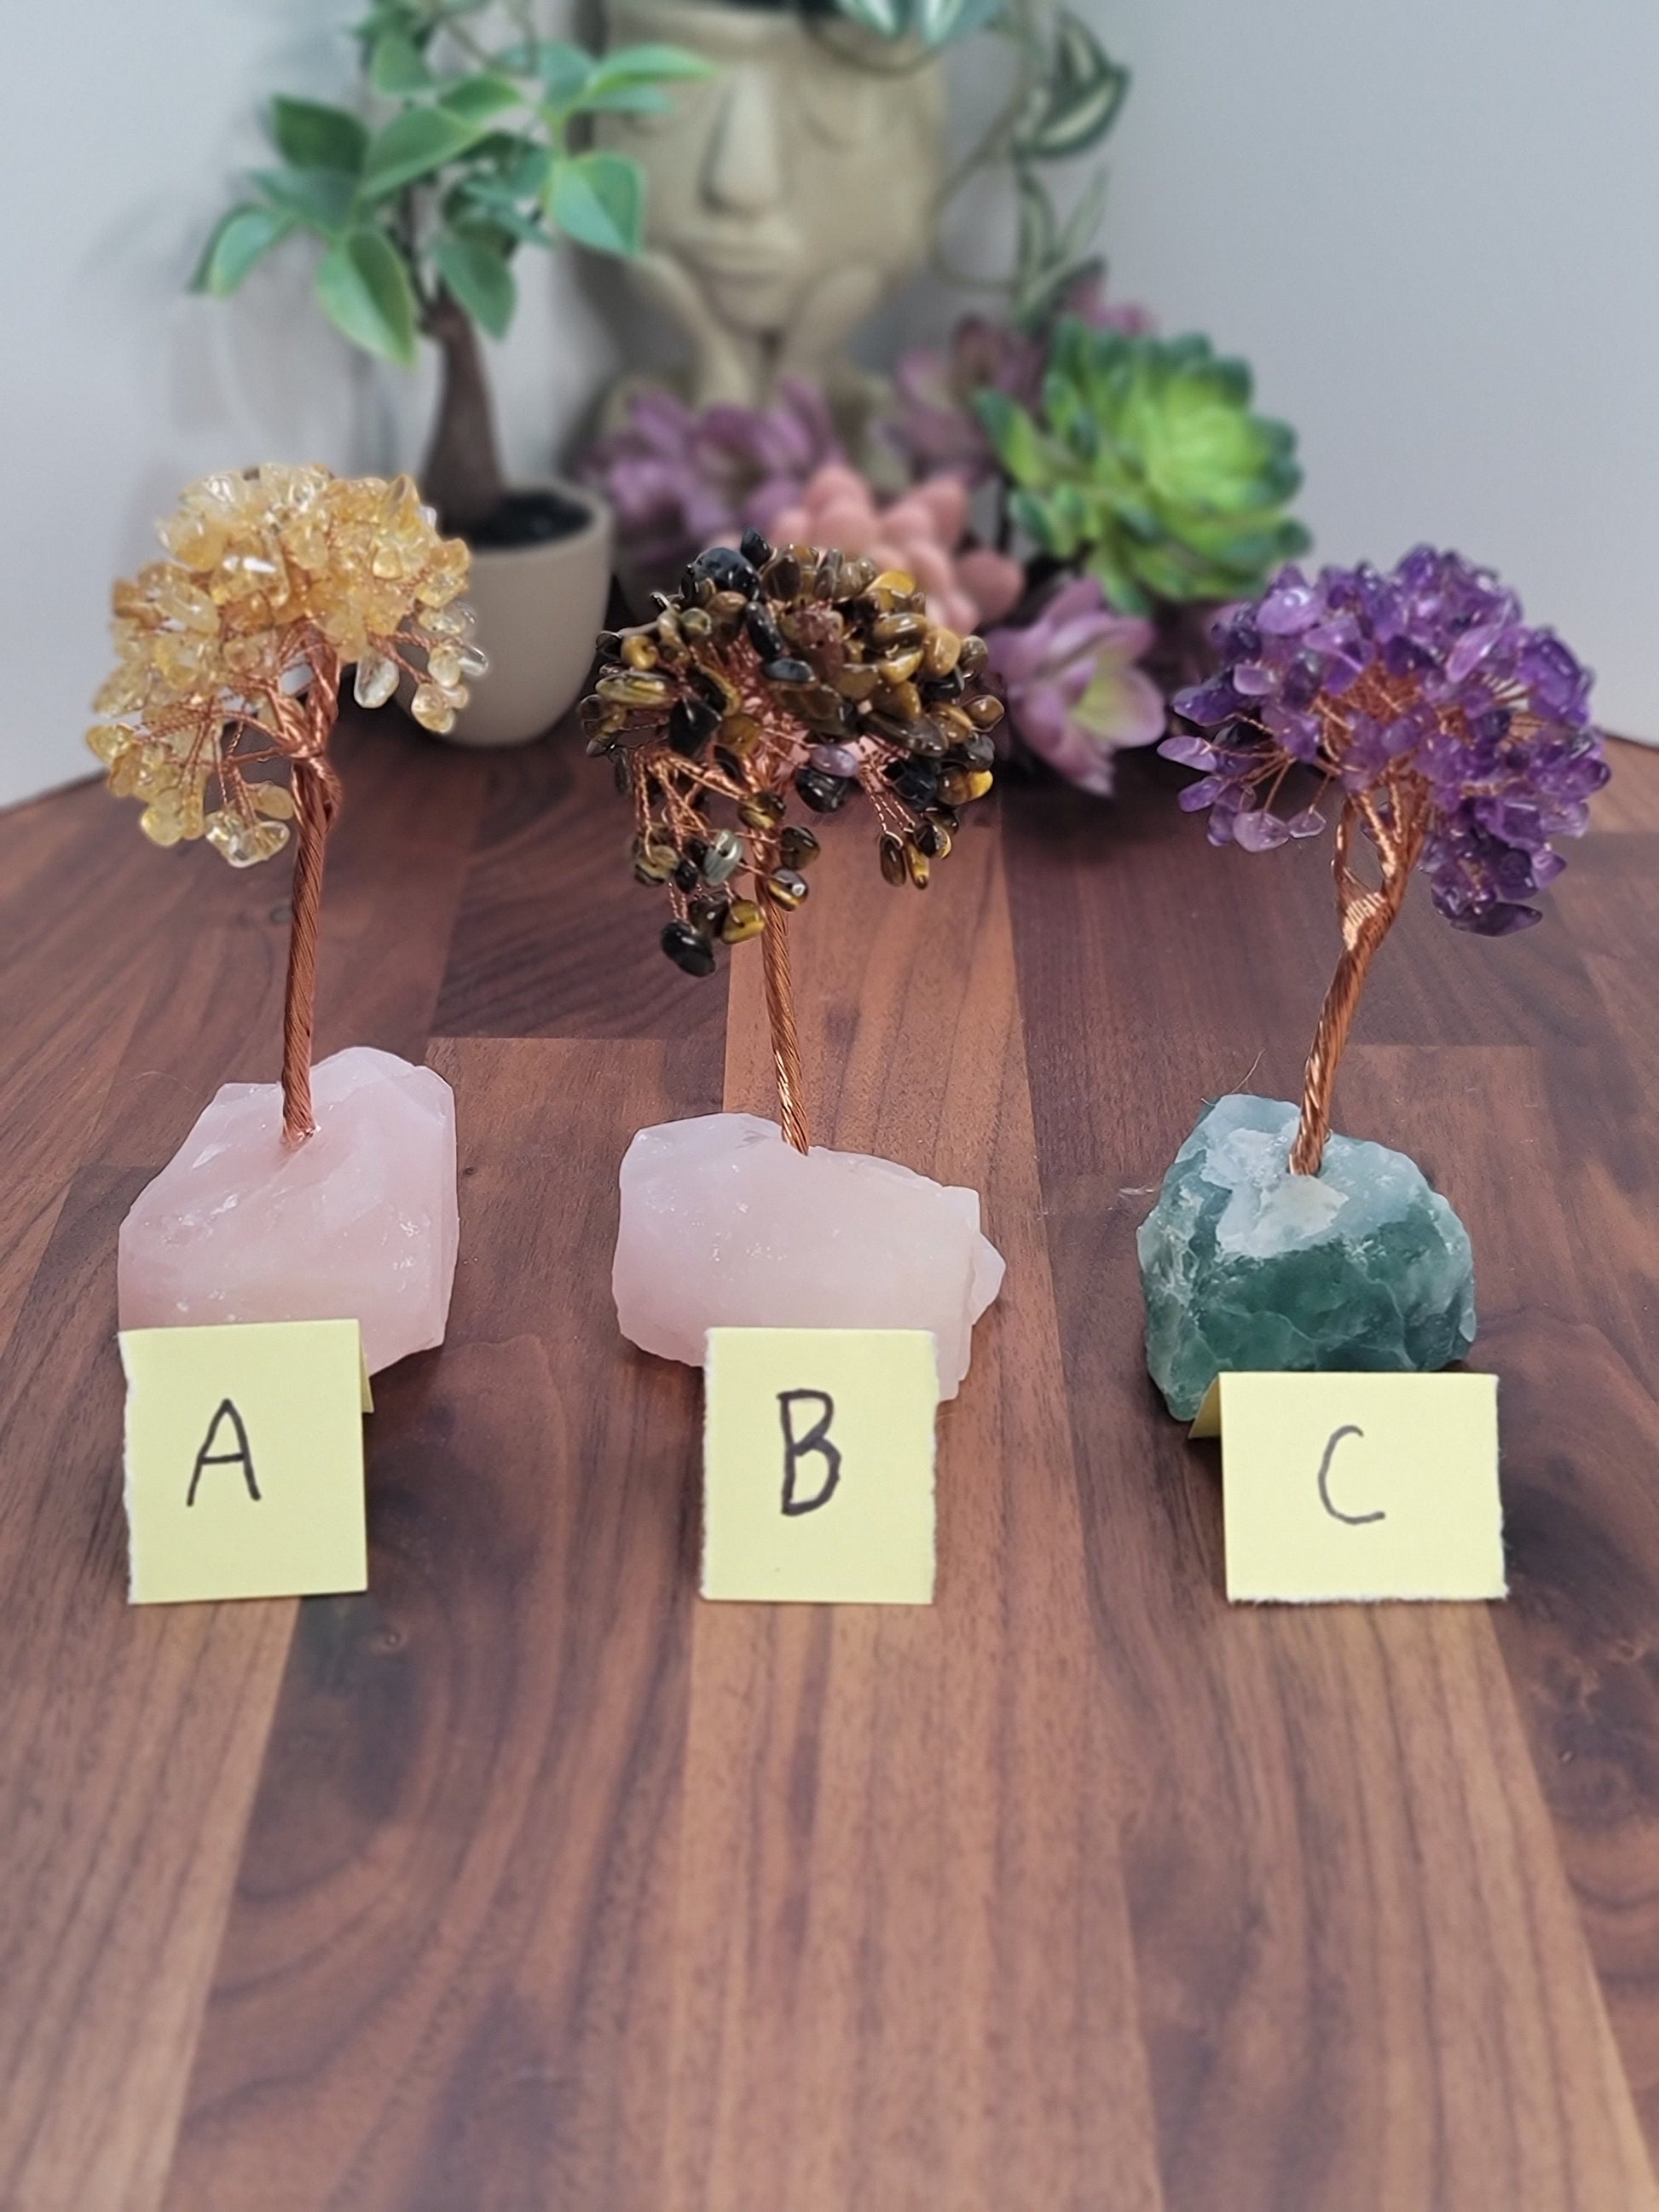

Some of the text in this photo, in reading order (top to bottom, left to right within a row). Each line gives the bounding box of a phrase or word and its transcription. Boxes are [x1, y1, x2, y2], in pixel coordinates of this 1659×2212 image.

[187, 1399, 261, 1506] A
[777, 1389, 841, 1516] B
[1319, 1425, 1385, 1525] C
